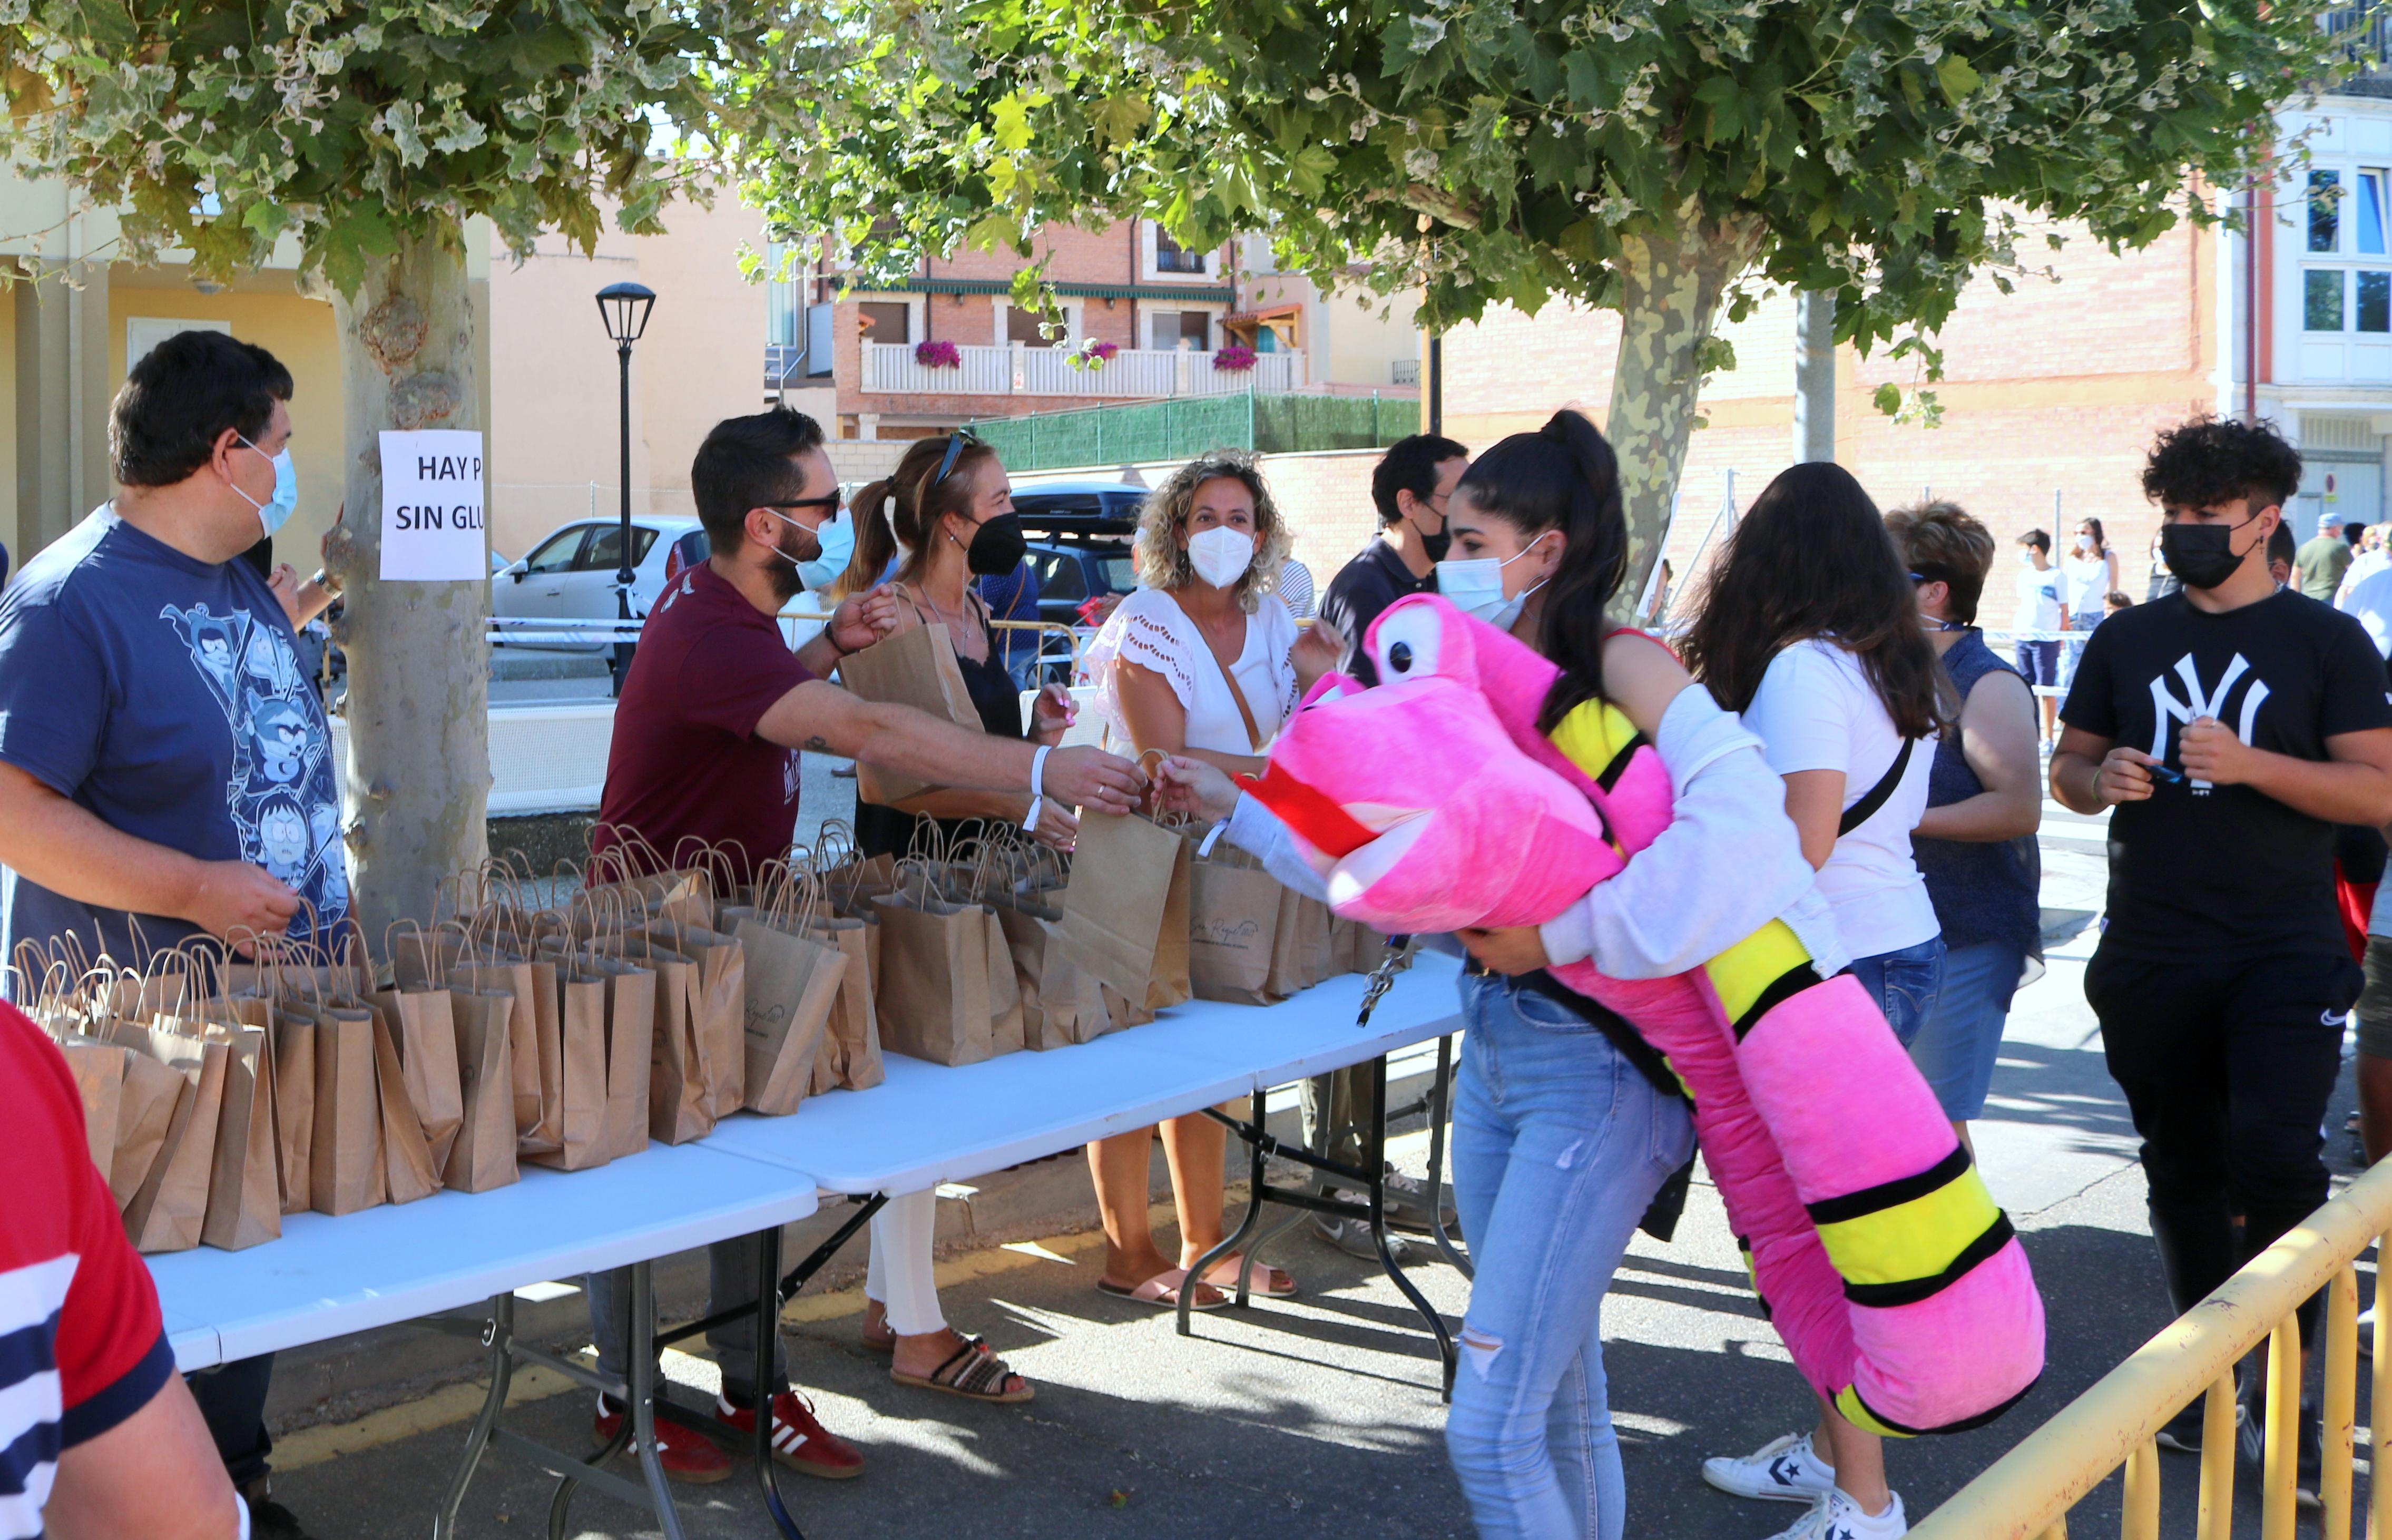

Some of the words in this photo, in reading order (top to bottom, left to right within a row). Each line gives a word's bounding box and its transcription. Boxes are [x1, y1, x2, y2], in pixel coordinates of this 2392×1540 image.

[418, 457, 467, 480] HAY
[474, 457, 483, 481] P
[396, 506, 442, 529] SIN
